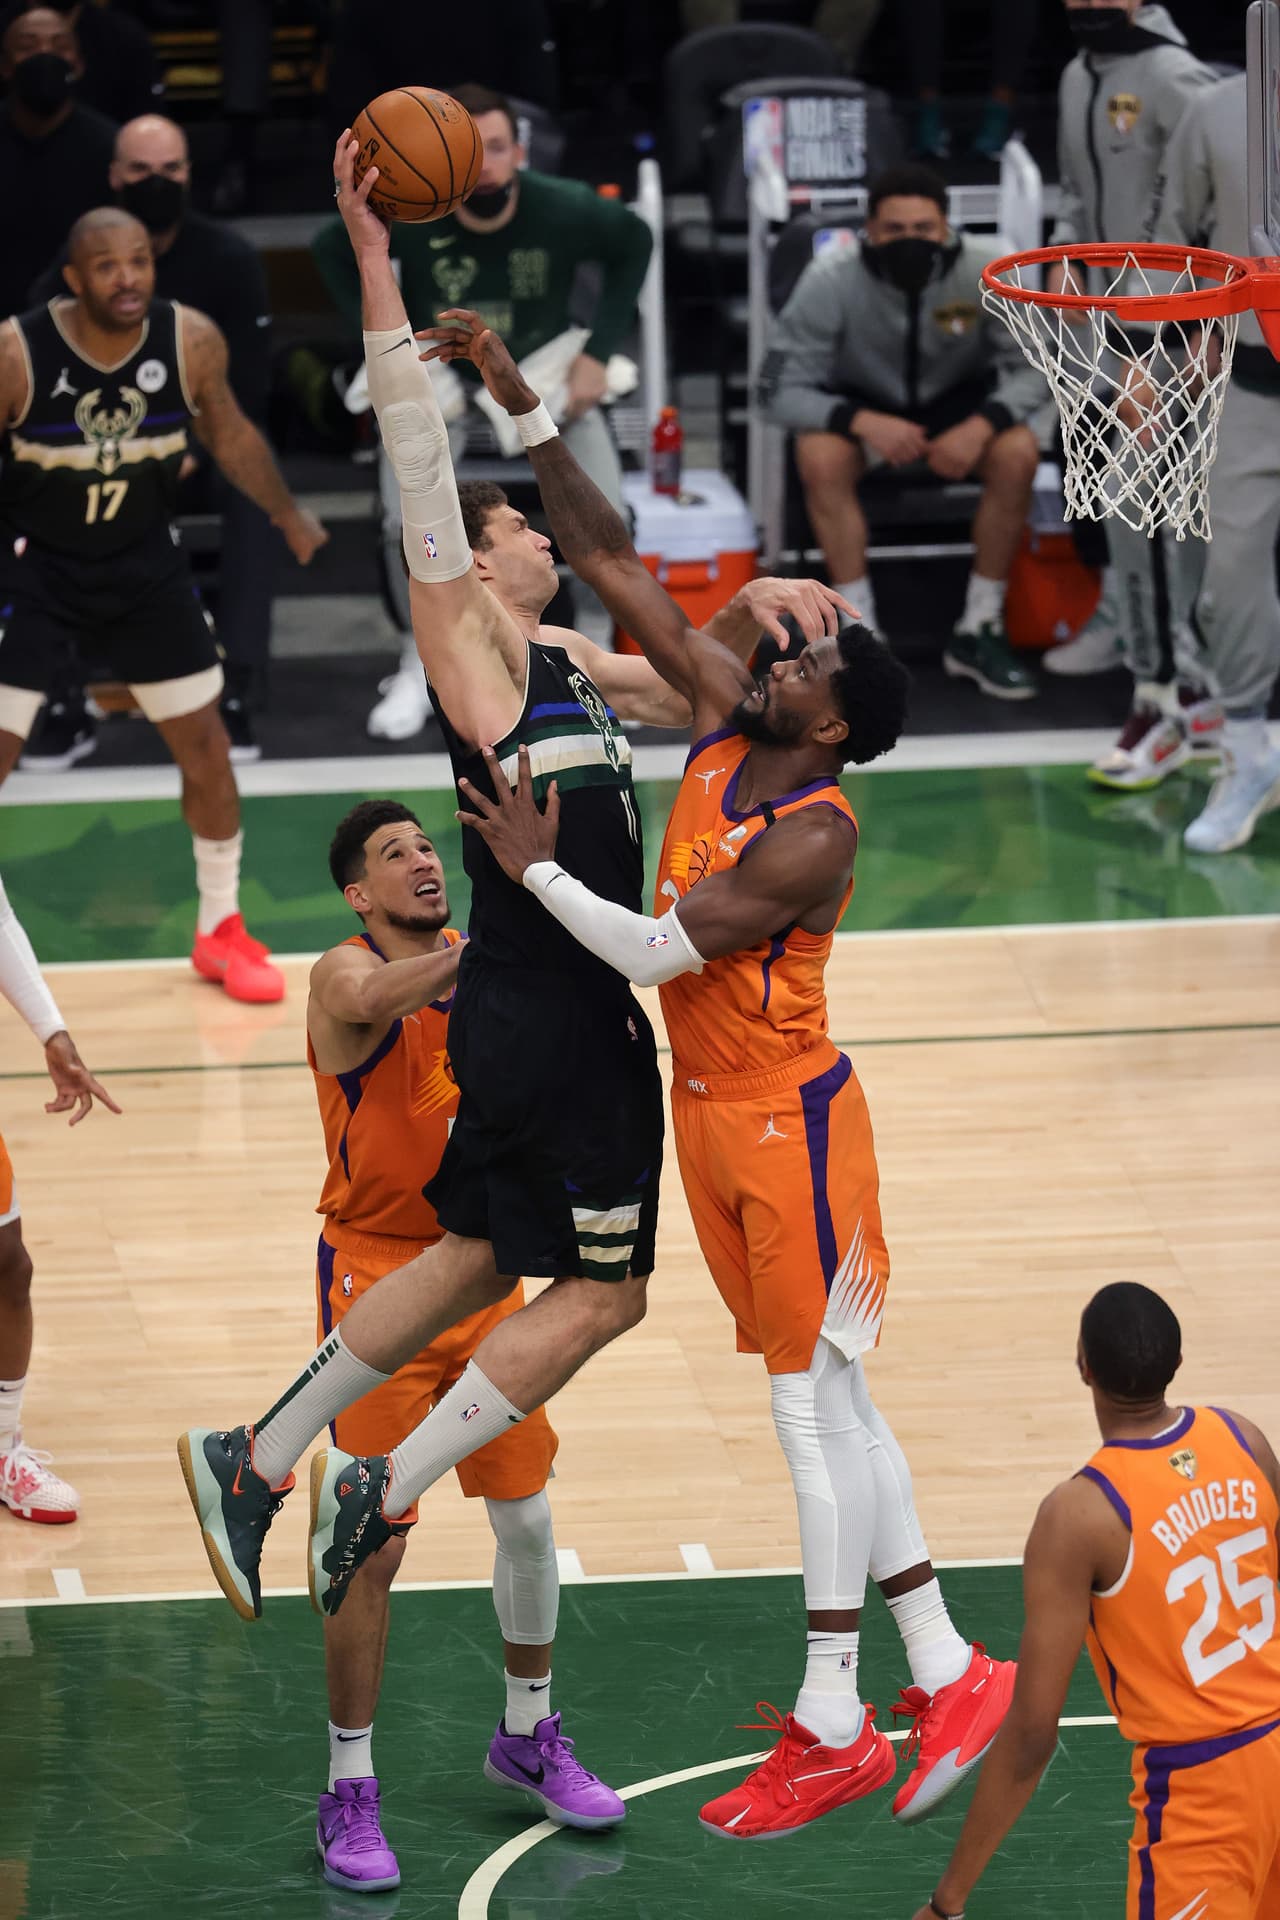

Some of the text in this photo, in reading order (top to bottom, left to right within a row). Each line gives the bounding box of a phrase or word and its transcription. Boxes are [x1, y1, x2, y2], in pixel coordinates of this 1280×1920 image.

[85, 480, 129, 524] 17
[687, 1079, 709, 1095] PHX
[1151, 1478, 1257, 1557] BRIDGES
[1165, 1526, 1276, 1688] 25
